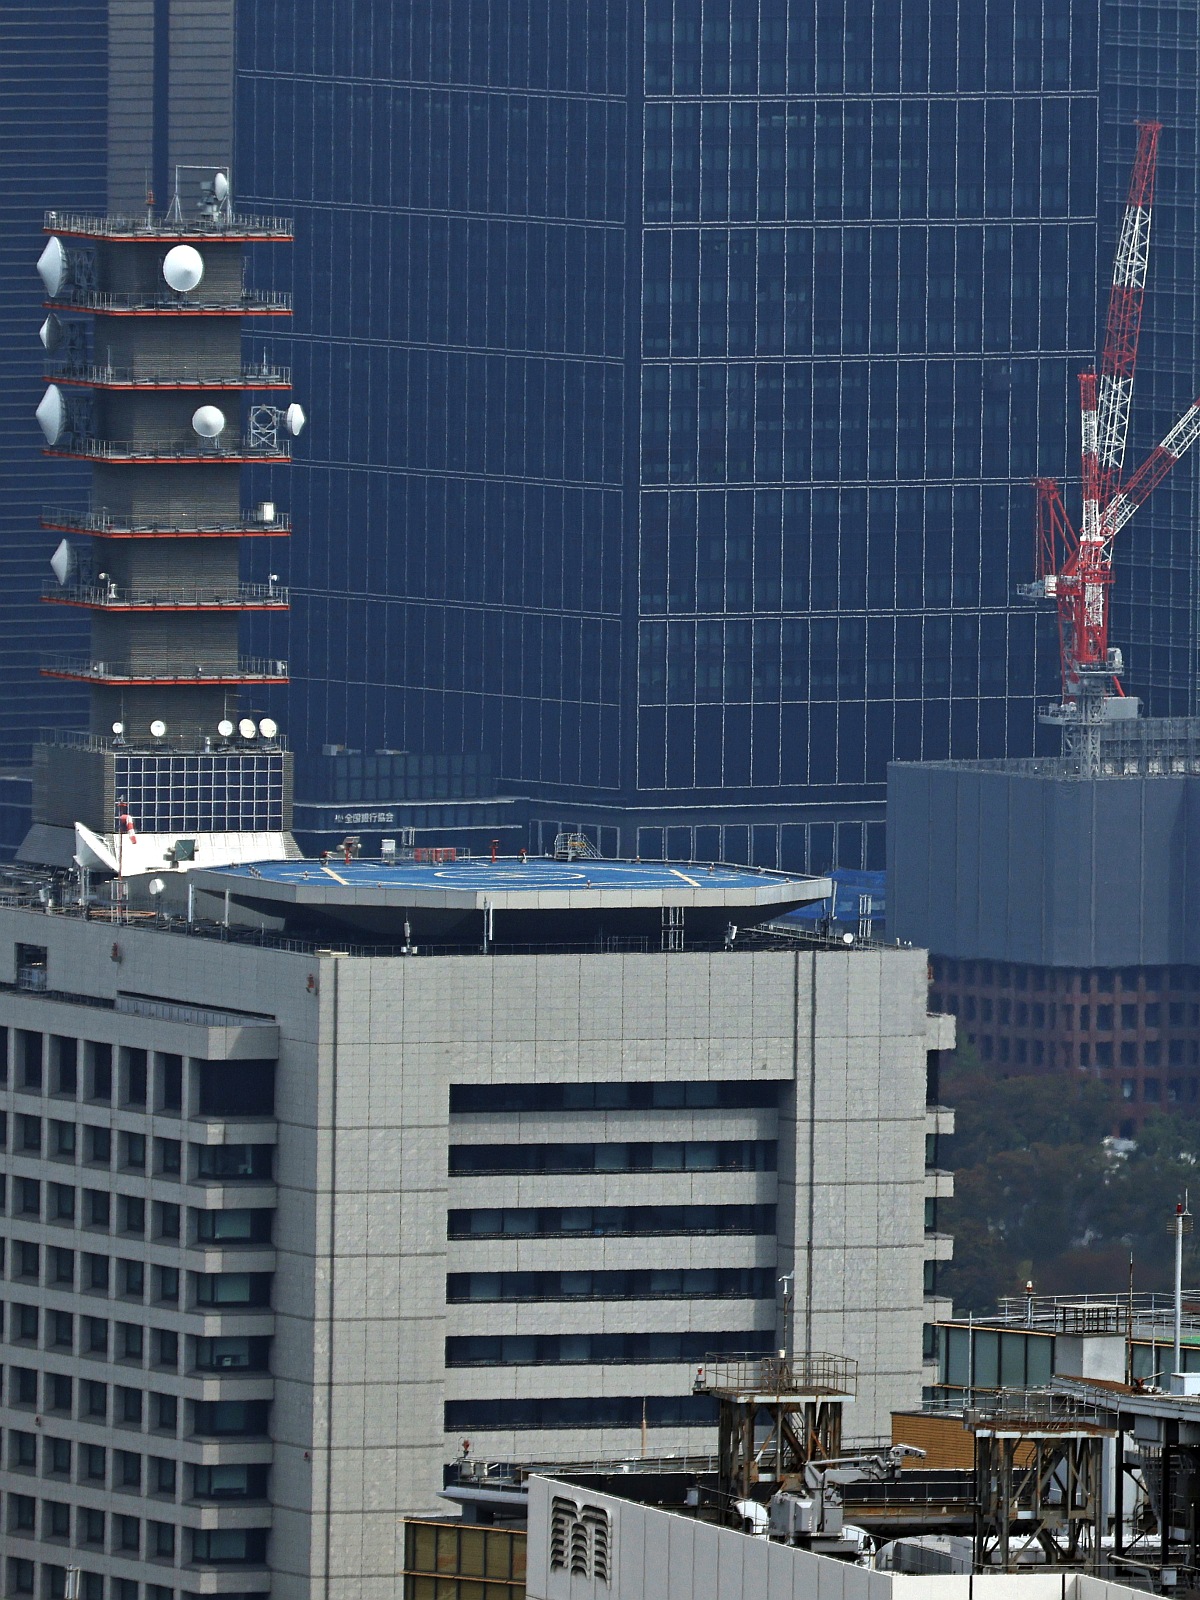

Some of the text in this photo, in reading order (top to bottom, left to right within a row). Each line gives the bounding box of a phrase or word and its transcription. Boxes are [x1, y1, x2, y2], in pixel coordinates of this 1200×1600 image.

[344, 812, 394, 823] 全国銀行協会
